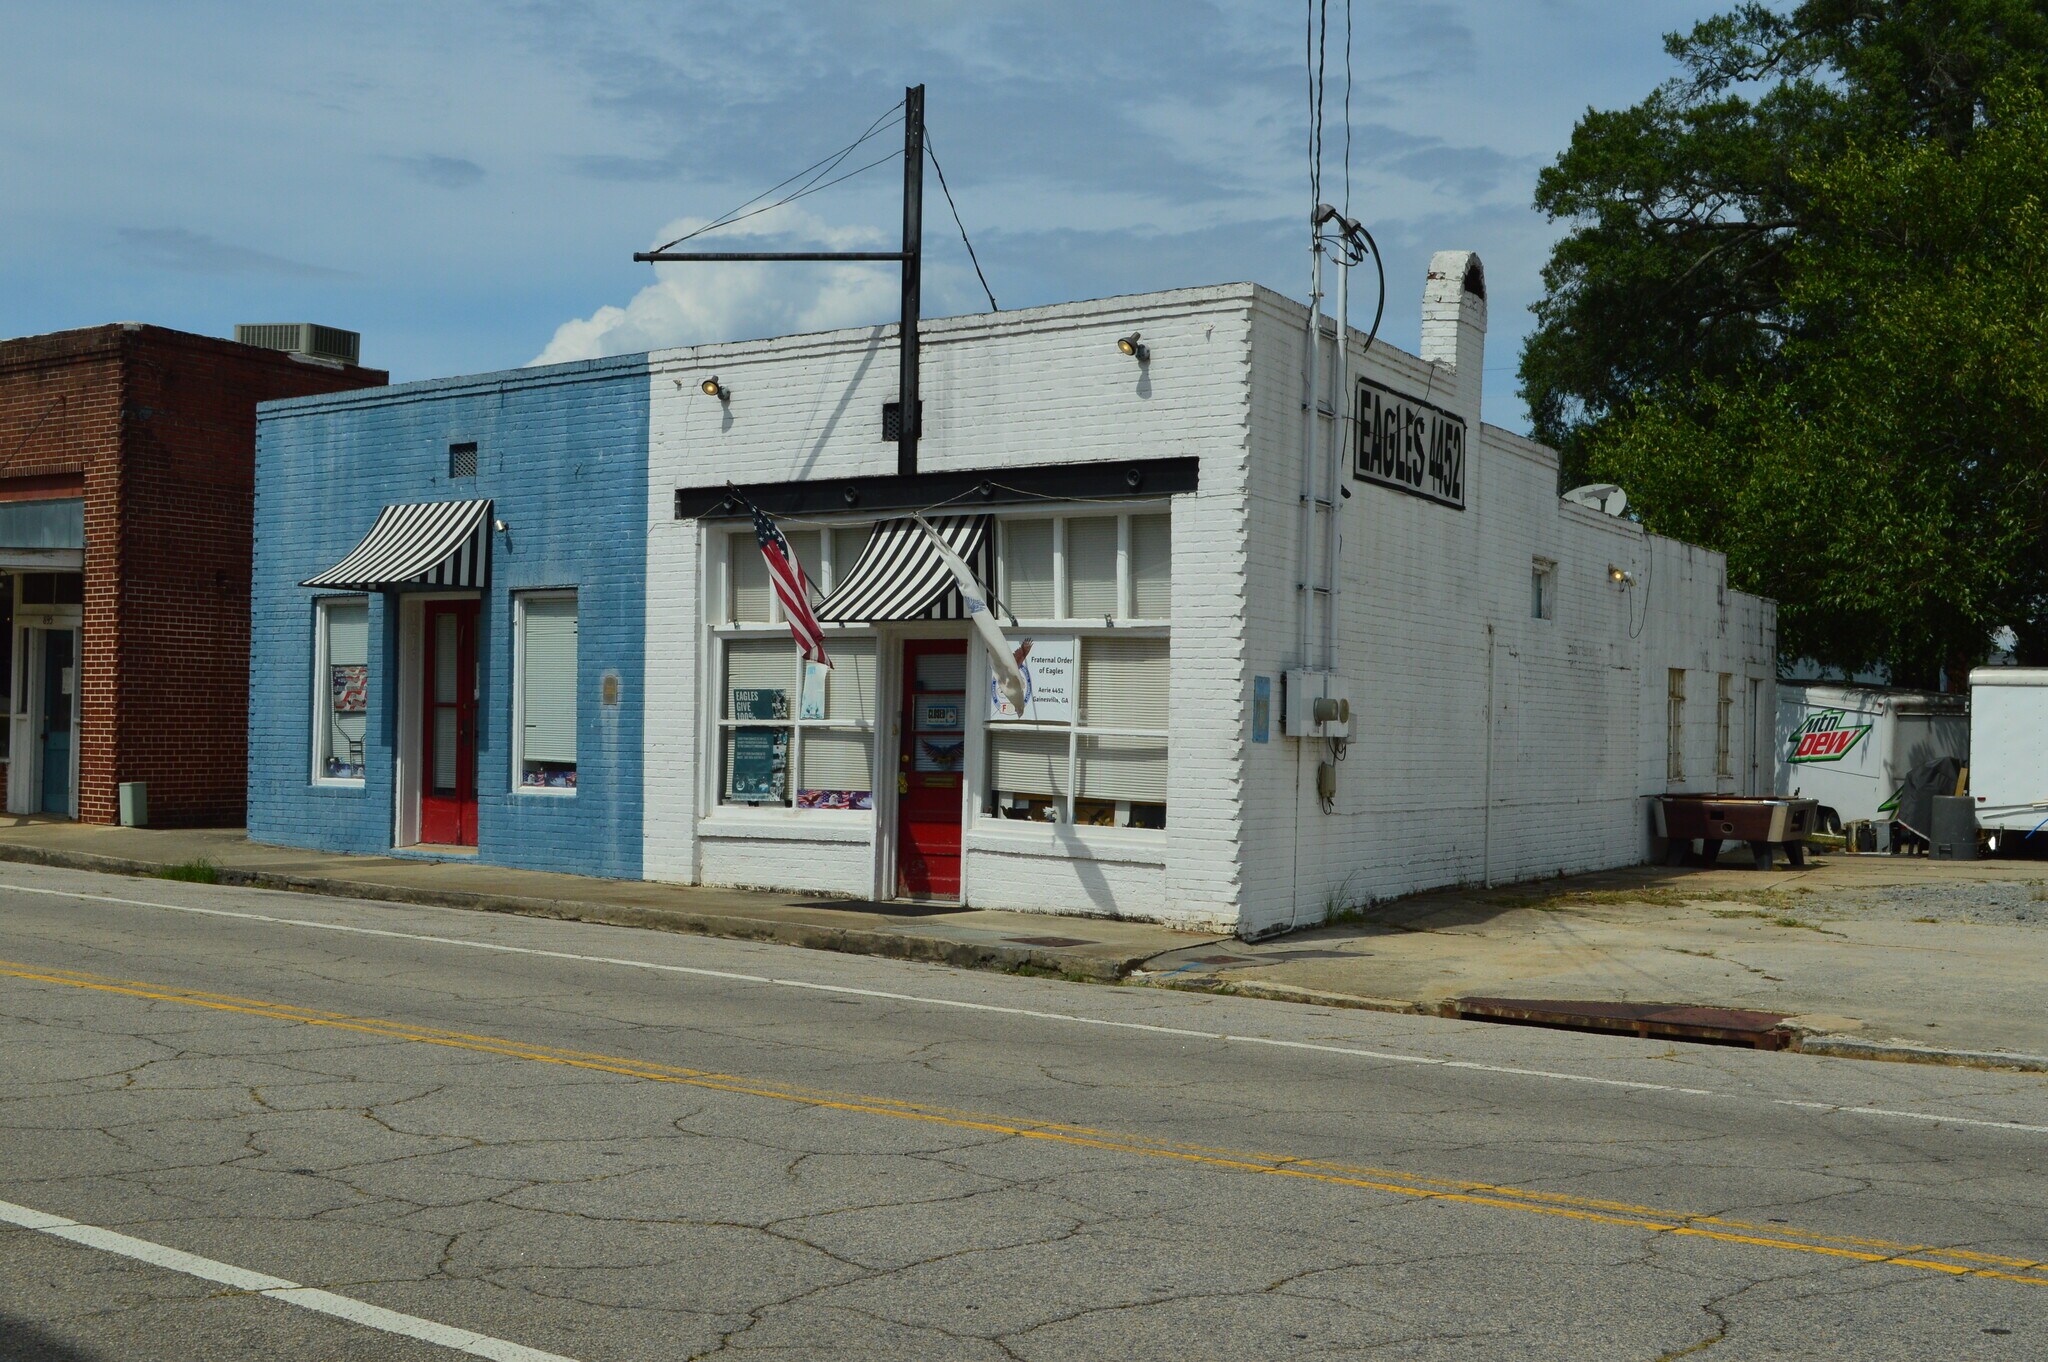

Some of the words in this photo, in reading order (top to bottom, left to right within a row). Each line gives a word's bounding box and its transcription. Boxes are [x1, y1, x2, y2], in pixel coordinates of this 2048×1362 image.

[1360, 389, 1425, 488] EAGLES
[1428, 416, 1460, 500] 4452
[1031, 656, 1056, 664] Fraternal
[1057, 656, 1073, 664] Order
[1046, 667, 1064, 676] Eagles
[735, 691, 759, 701] EAGLES
[736, 702, 751, 711] GIVE
[1801, 714, 1839, 734] Mtn
